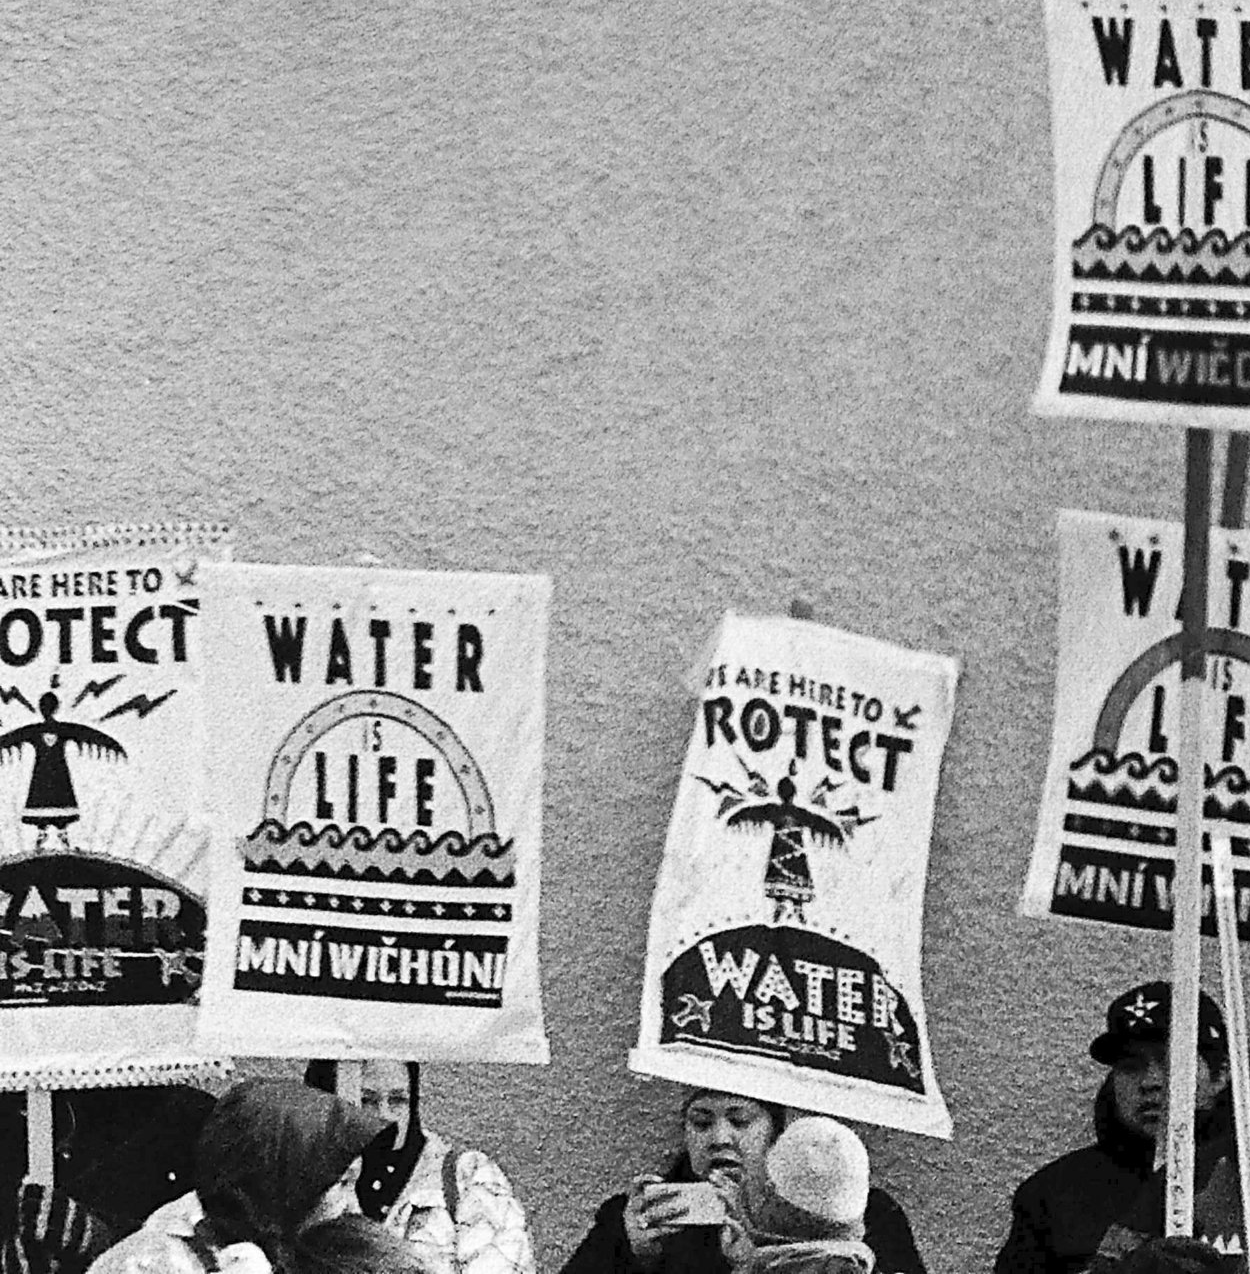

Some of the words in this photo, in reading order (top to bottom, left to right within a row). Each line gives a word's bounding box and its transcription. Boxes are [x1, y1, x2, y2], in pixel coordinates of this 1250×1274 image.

[1066, 334, 1150, 383] MNÍ
[52, 570, 118, 598] HERE
[126, 567, 163, 595] TO
[263, 614, 485, 693] WATER
[736, 666, 781, 695] ARE
[851, 691, 884, 723] TO
[362, 719, 383, 752] IS
[314, 751, 437, 827] LIFE
[1055, 861, 1150, 909] MNÍ
[43, 947, 123, 979] LIFE
[238, 929, 326, 978] MNÍ
[328, 935, 508, 989] WIČHÓNI
[699, 939, 905, 1037] WATER
[742, 1002, 777, 1032] IS
[782, 1011, 857, 1052] LIFE
